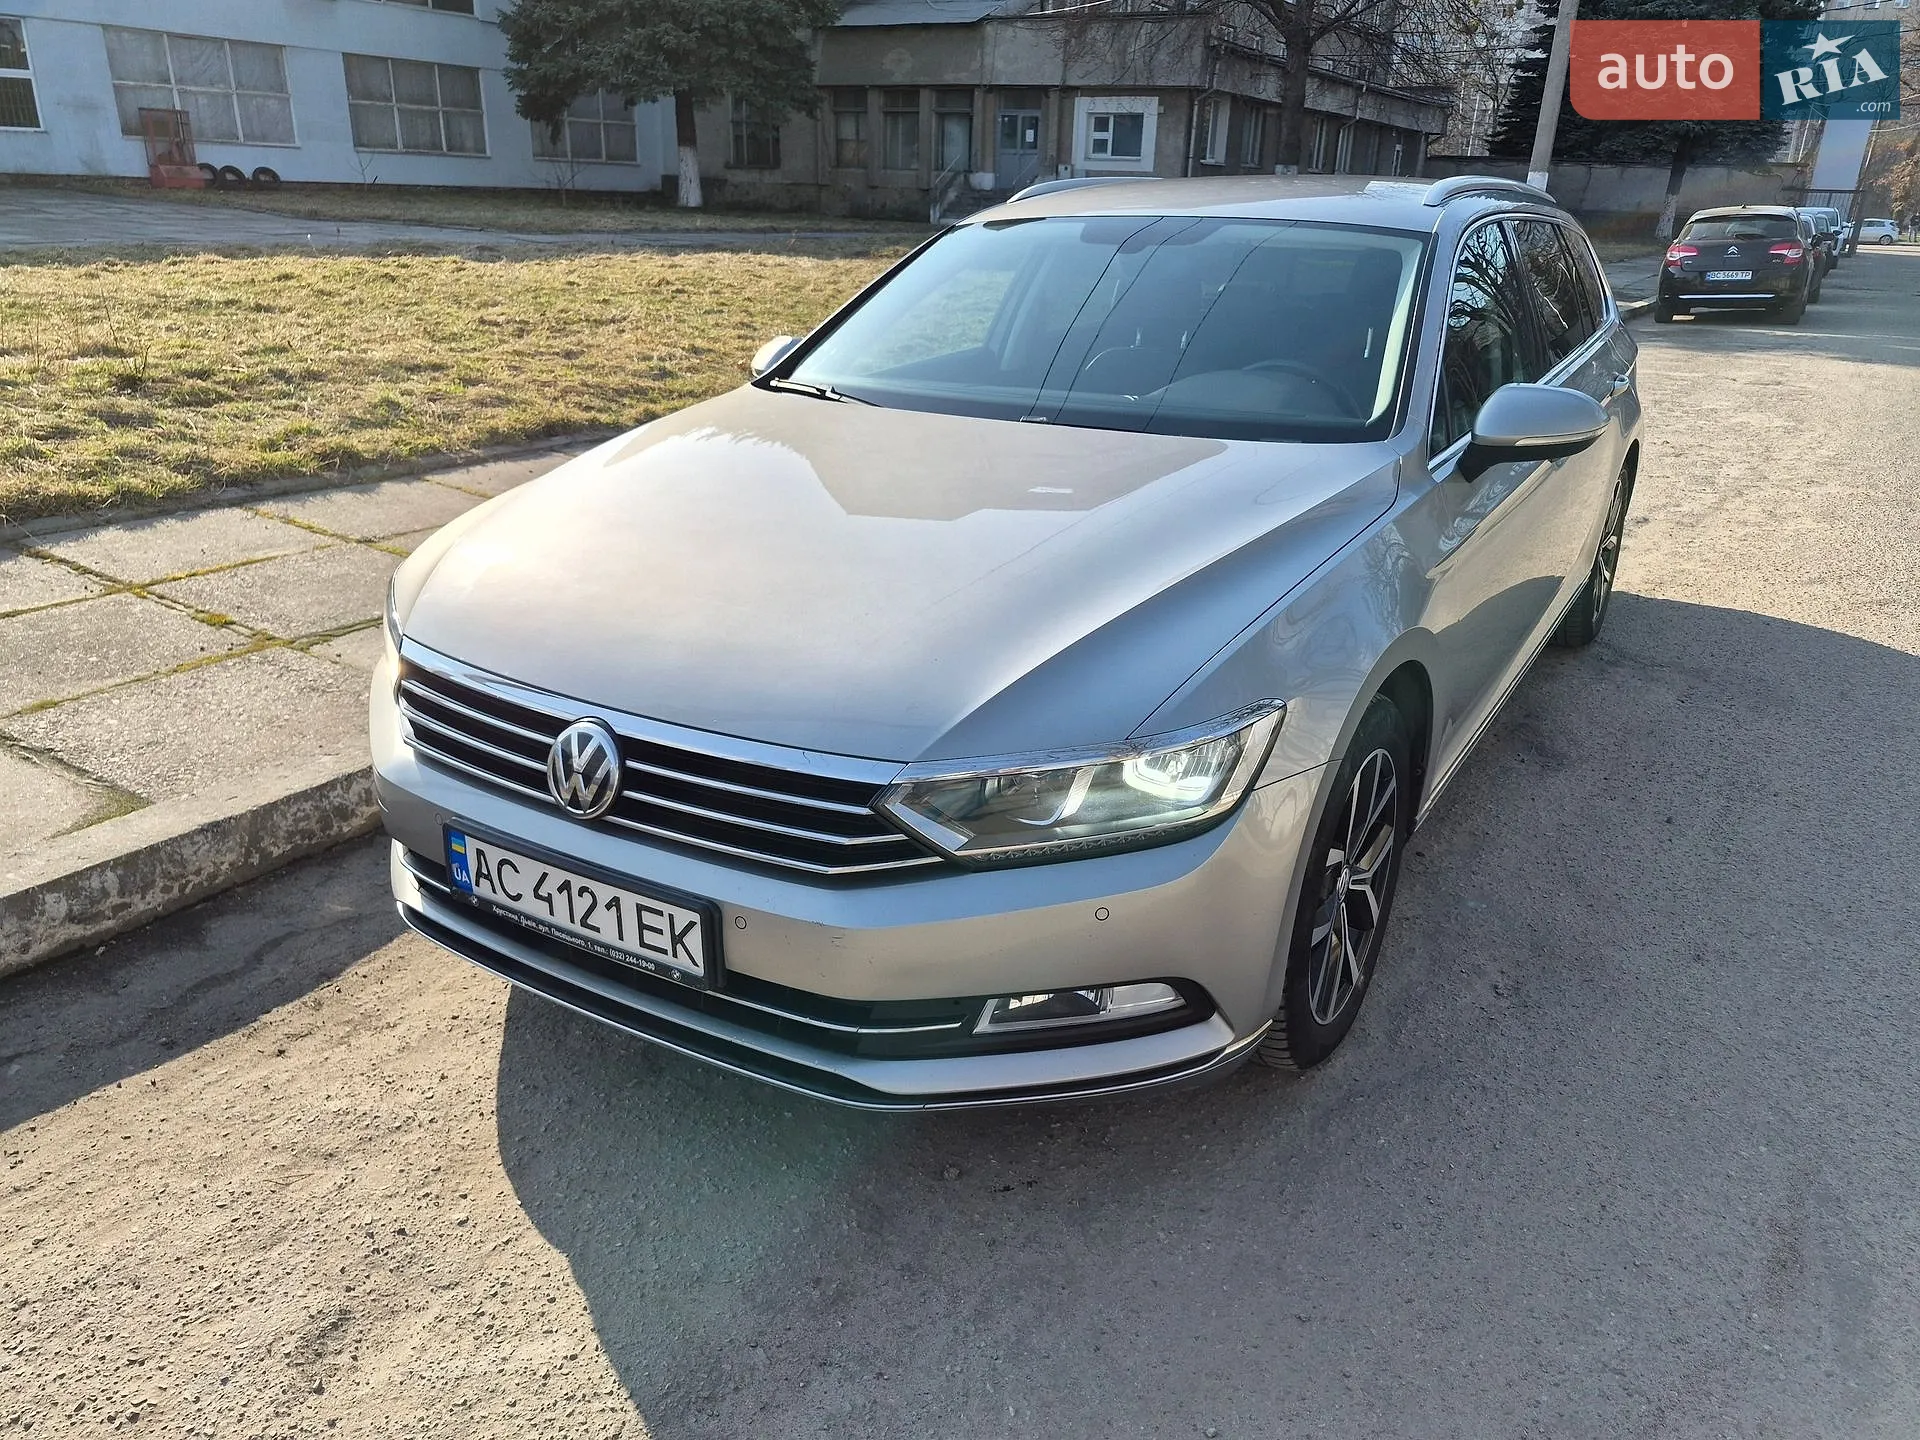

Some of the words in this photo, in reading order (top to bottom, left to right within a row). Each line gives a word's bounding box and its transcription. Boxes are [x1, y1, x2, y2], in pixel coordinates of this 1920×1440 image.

[1710, 271, 1721, 279] BC
[1722, 271, 1739, 279] 5669
[1740, 271, 1751, 279] TP
[454, 866, 470, 884] UA
[474, 847, 523, 902] AC
[533, 871, 624, 942] 4121
[636, 902, 700, 967] EK
